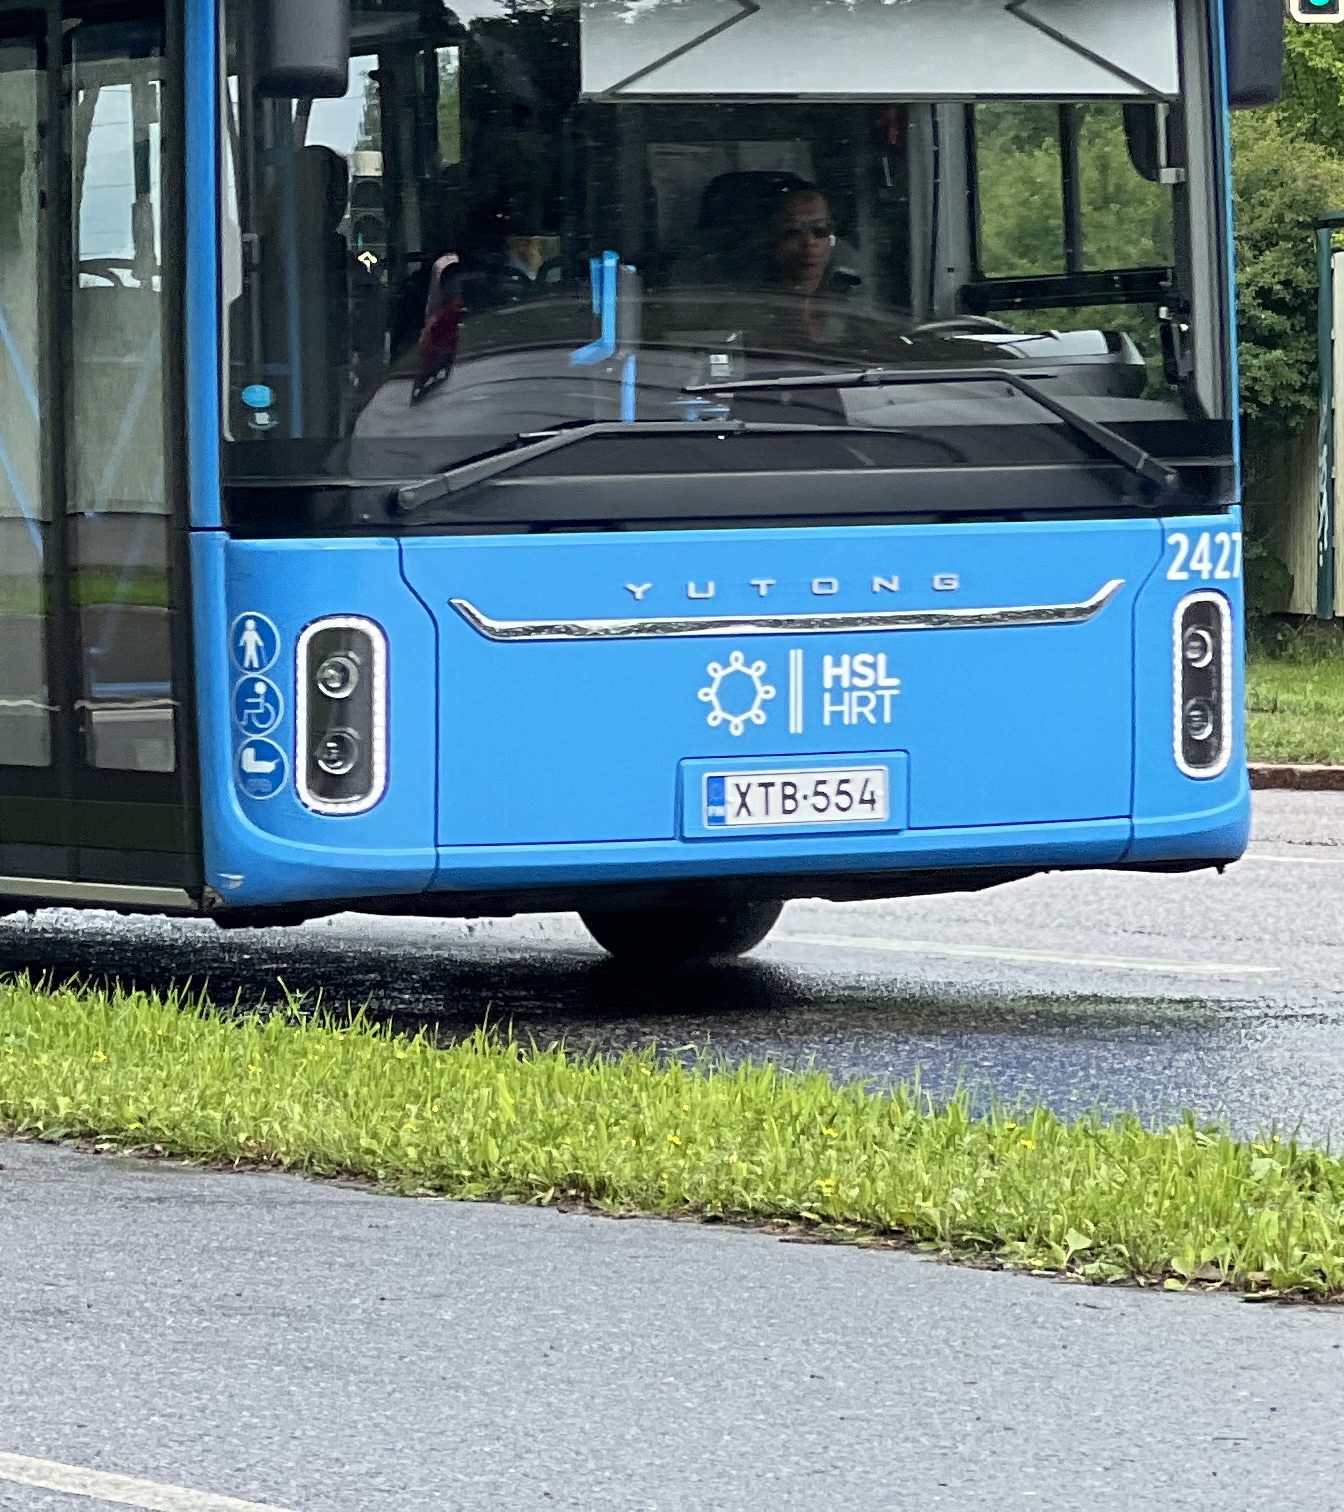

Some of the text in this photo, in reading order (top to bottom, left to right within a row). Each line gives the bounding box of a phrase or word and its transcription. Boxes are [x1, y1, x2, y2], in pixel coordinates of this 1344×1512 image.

[1166, 531, 1242, 581] 2427
[624, 573, 960, 600] YUTONG
[822, 652, 901, 689] HSL
[822, 688, 900, 726] HRT
